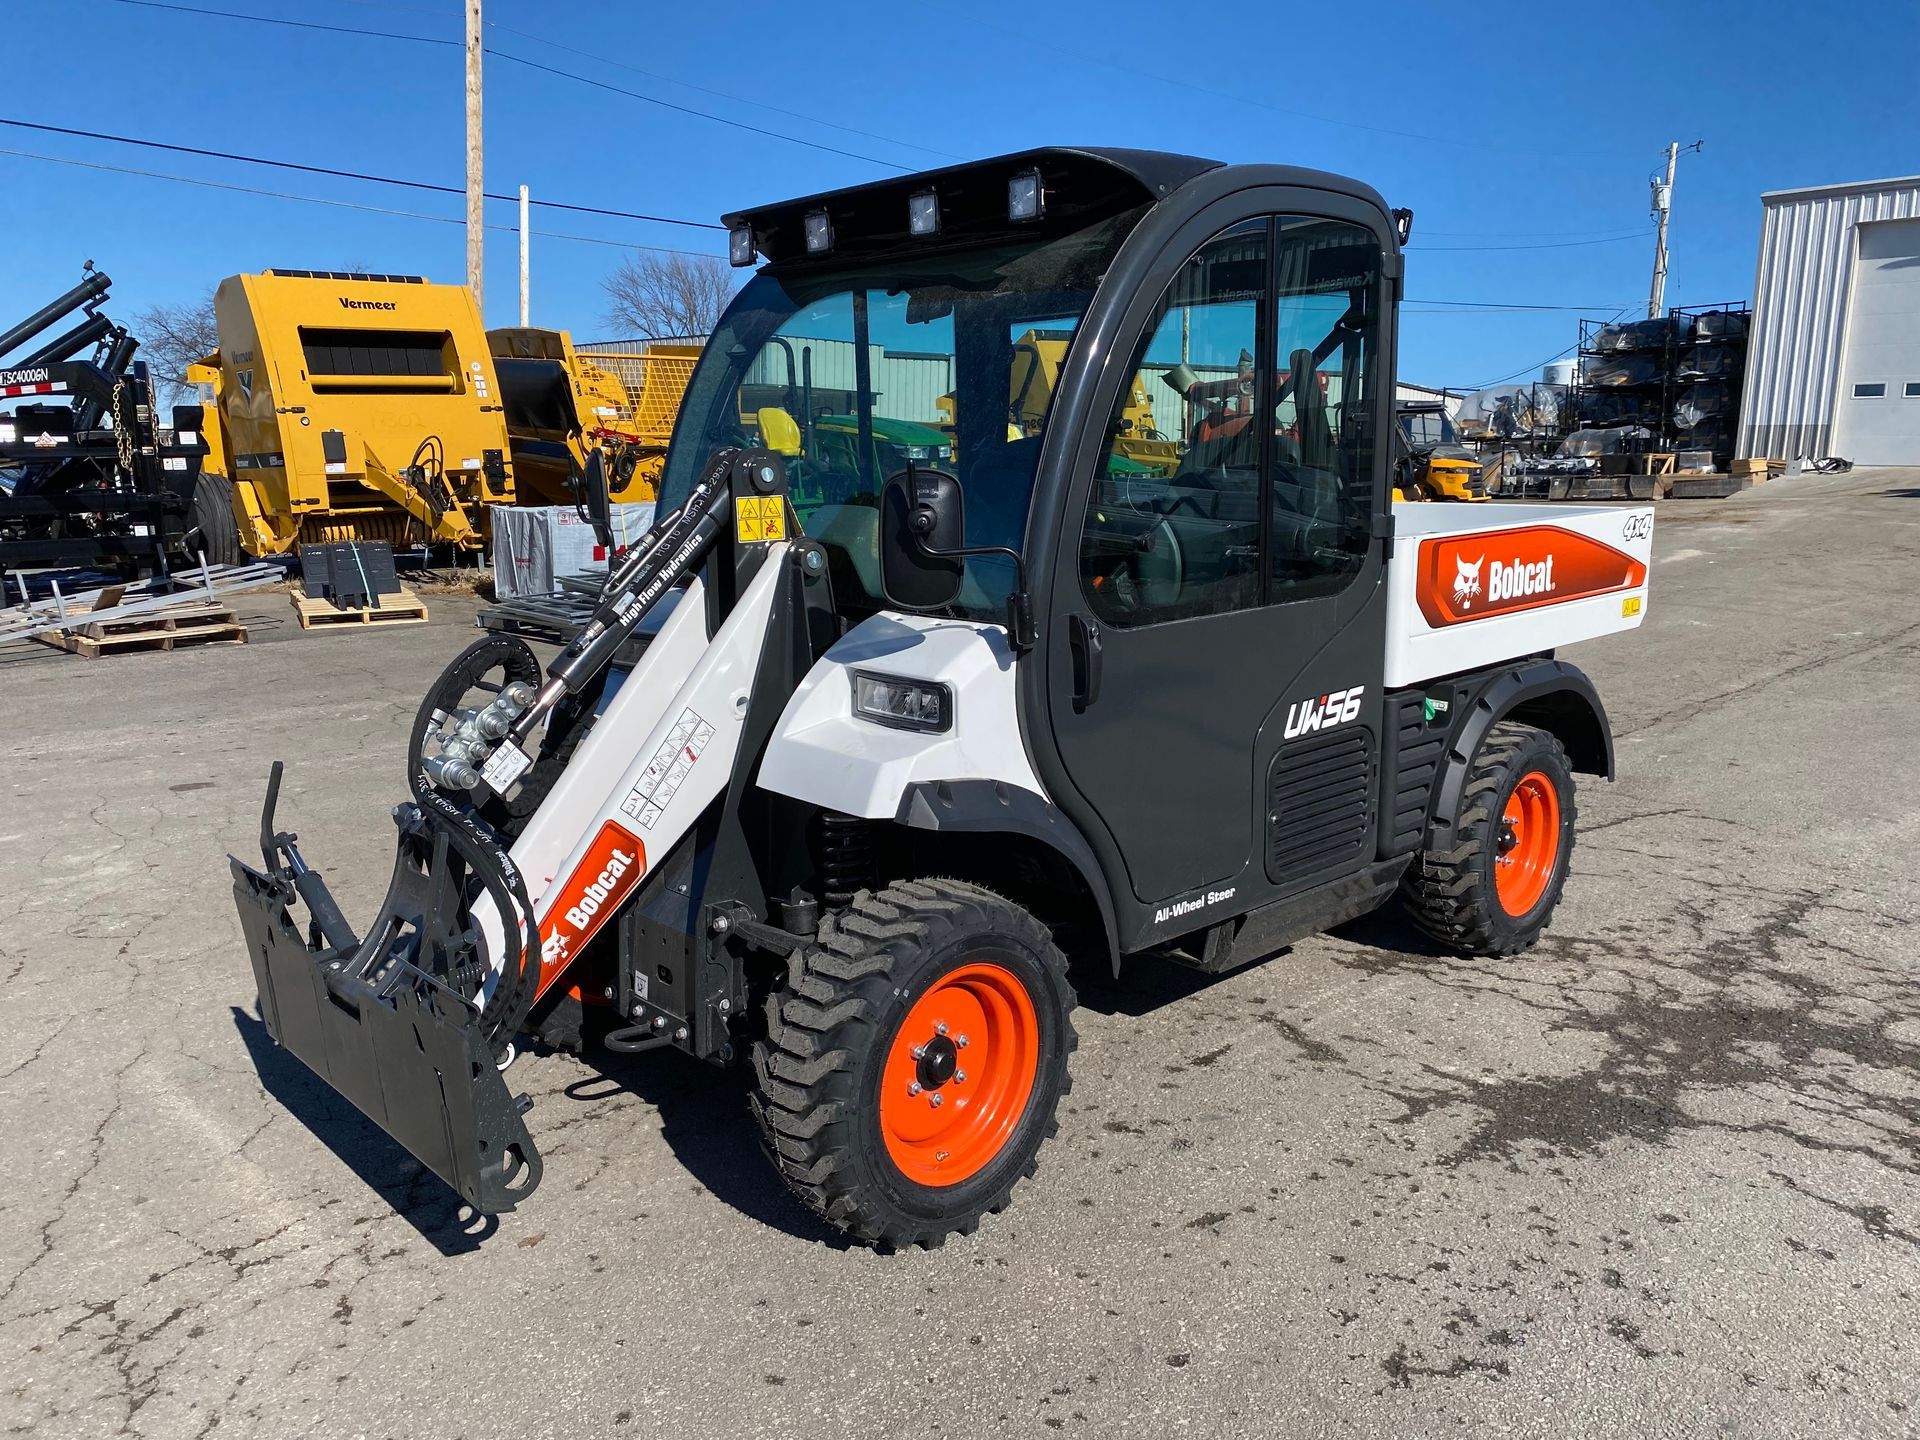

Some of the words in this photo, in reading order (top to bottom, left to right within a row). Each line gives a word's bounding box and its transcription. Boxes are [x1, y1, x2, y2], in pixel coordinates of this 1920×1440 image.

[339, 297, 396, 311] Vermeer
[1623, 514, 1652, 541] 4x4
[620, 601, 643, 627] High
[637, 580, 663, 605] Flow
[658, 533, 703, 582] Hydraulics
[1283, 685, 1365, 740] UW56
[1154, 895, 1205, 924] All-Wheel
[1207, 887, 1236, 905] Steer
